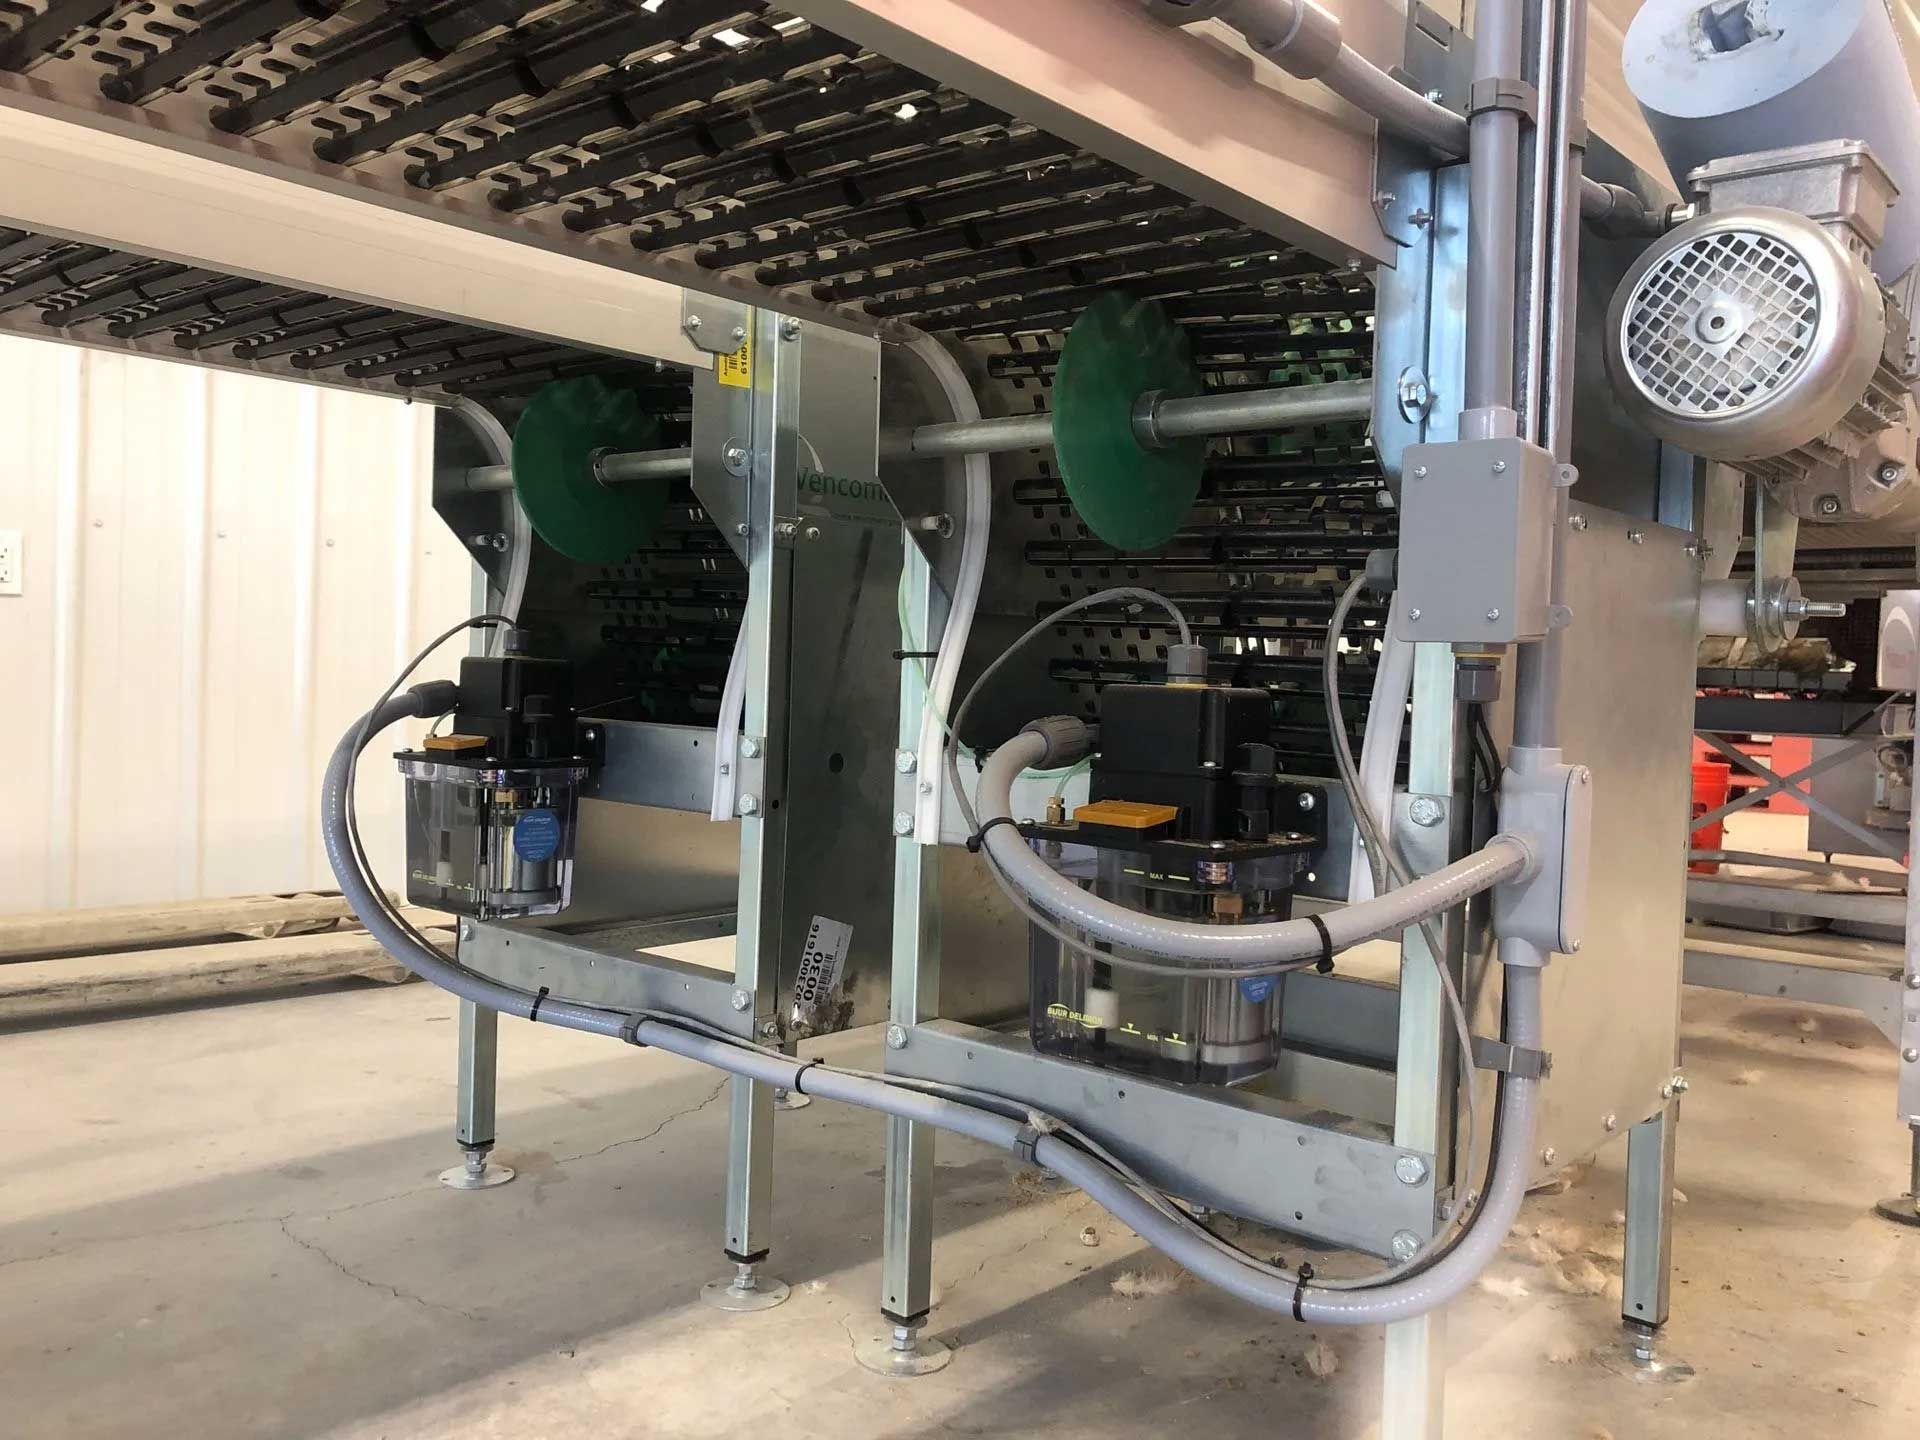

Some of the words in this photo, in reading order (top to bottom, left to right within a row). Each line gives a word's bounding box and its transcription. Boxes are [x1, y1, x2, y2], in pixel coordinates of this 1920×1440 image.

[740, 341, 748, 375] 6100
[1149, 872, 1164, 880] MAX
[803, 951, 824, 1002] 0030
